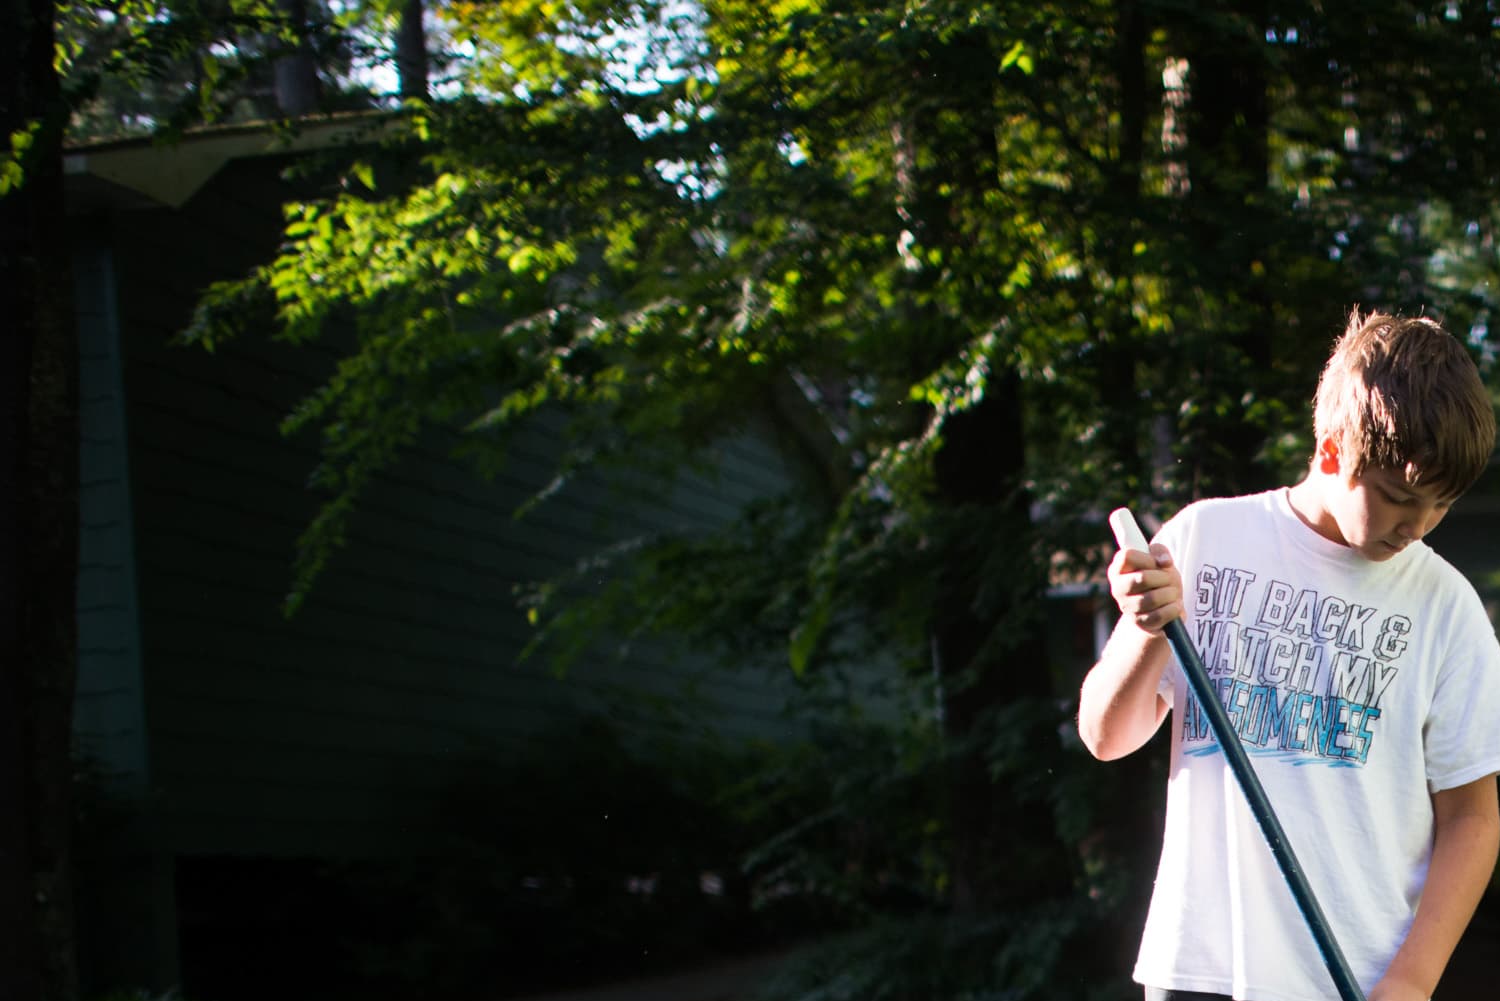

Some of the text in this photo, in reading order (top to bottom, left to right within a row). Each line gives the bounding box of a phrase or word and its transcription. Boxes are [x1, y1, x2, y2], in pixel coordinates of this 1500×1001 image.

[1195, 564, 1413, 662] SIT BACK &
[1193, 619, 1399, 709] WATCH MY
